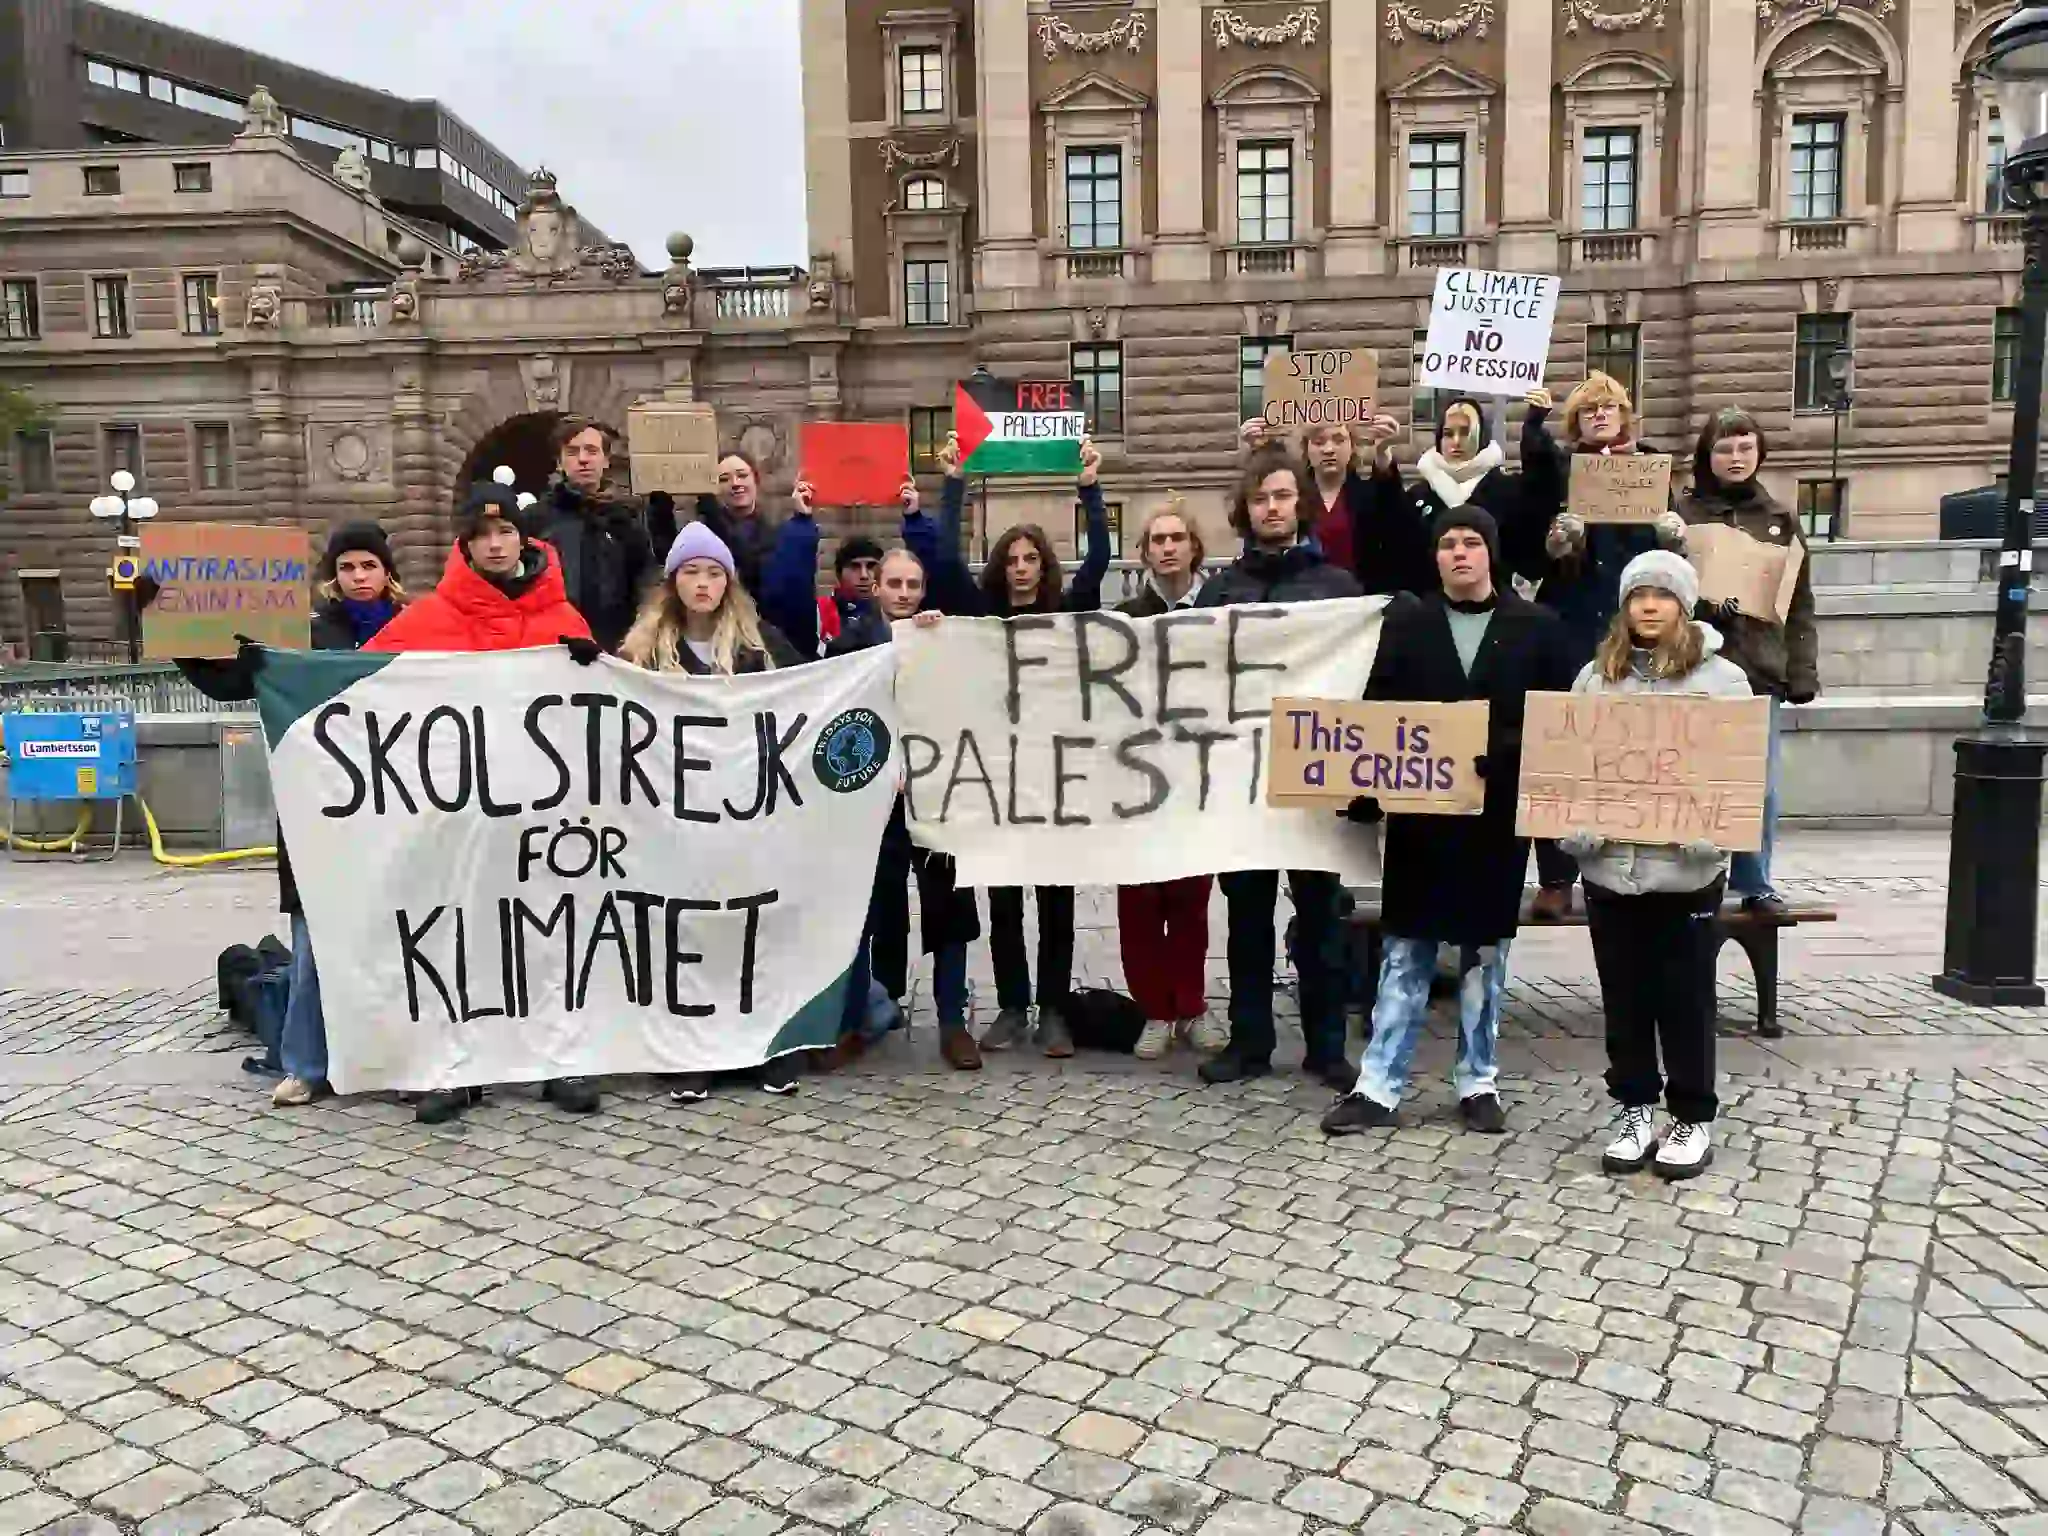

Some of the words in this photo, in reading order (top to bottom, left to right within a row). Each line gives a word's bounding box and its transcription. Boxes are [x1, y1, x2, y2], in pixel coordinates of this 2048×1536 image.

[1445, 271, 1549, 297] CLIMATE
[1444, 294, 1541, 319] JUSTICE
[1464, 330, 1503, 352] NO
[1287, 351, 1352, 377] STOP
[1425, 352, 1540, 382] OPRESSION
[1016, 382, 1072, 411] FREE
[1299, 377, 1332, 393] THE
[1003, 411, 1083, 438] PALESTINE
[1264, 396, 1371, 427] GENOCIDE
[144, 556, 306, 582] ANTIRASISM
[156, 584, 297, 613] EMINISM
[1005, 607, 1289, 726] FREE
[816, 712, 852, 756] FRIDAYS
[855, 711, 874, 729] FOR
[1286, 709, 1365, 753] This
[1396, 716, 1431, 754] is
[313, 692, 807, 823] SKOLSTREJK
[1303, 759, 1325, 786] a
[1350, 752, 1456, 791] CRISIS
[1592, 747, 1685, 785] FOR
[835, 759, 881, 789] FUTURE
[899, 726, 1264, 827] PALESTI
[1526, 784, 1734, 831] PALESTINE
[517, 815, 628, 883] FÖR
[396, 888, 779, 1024] KLIMATET
